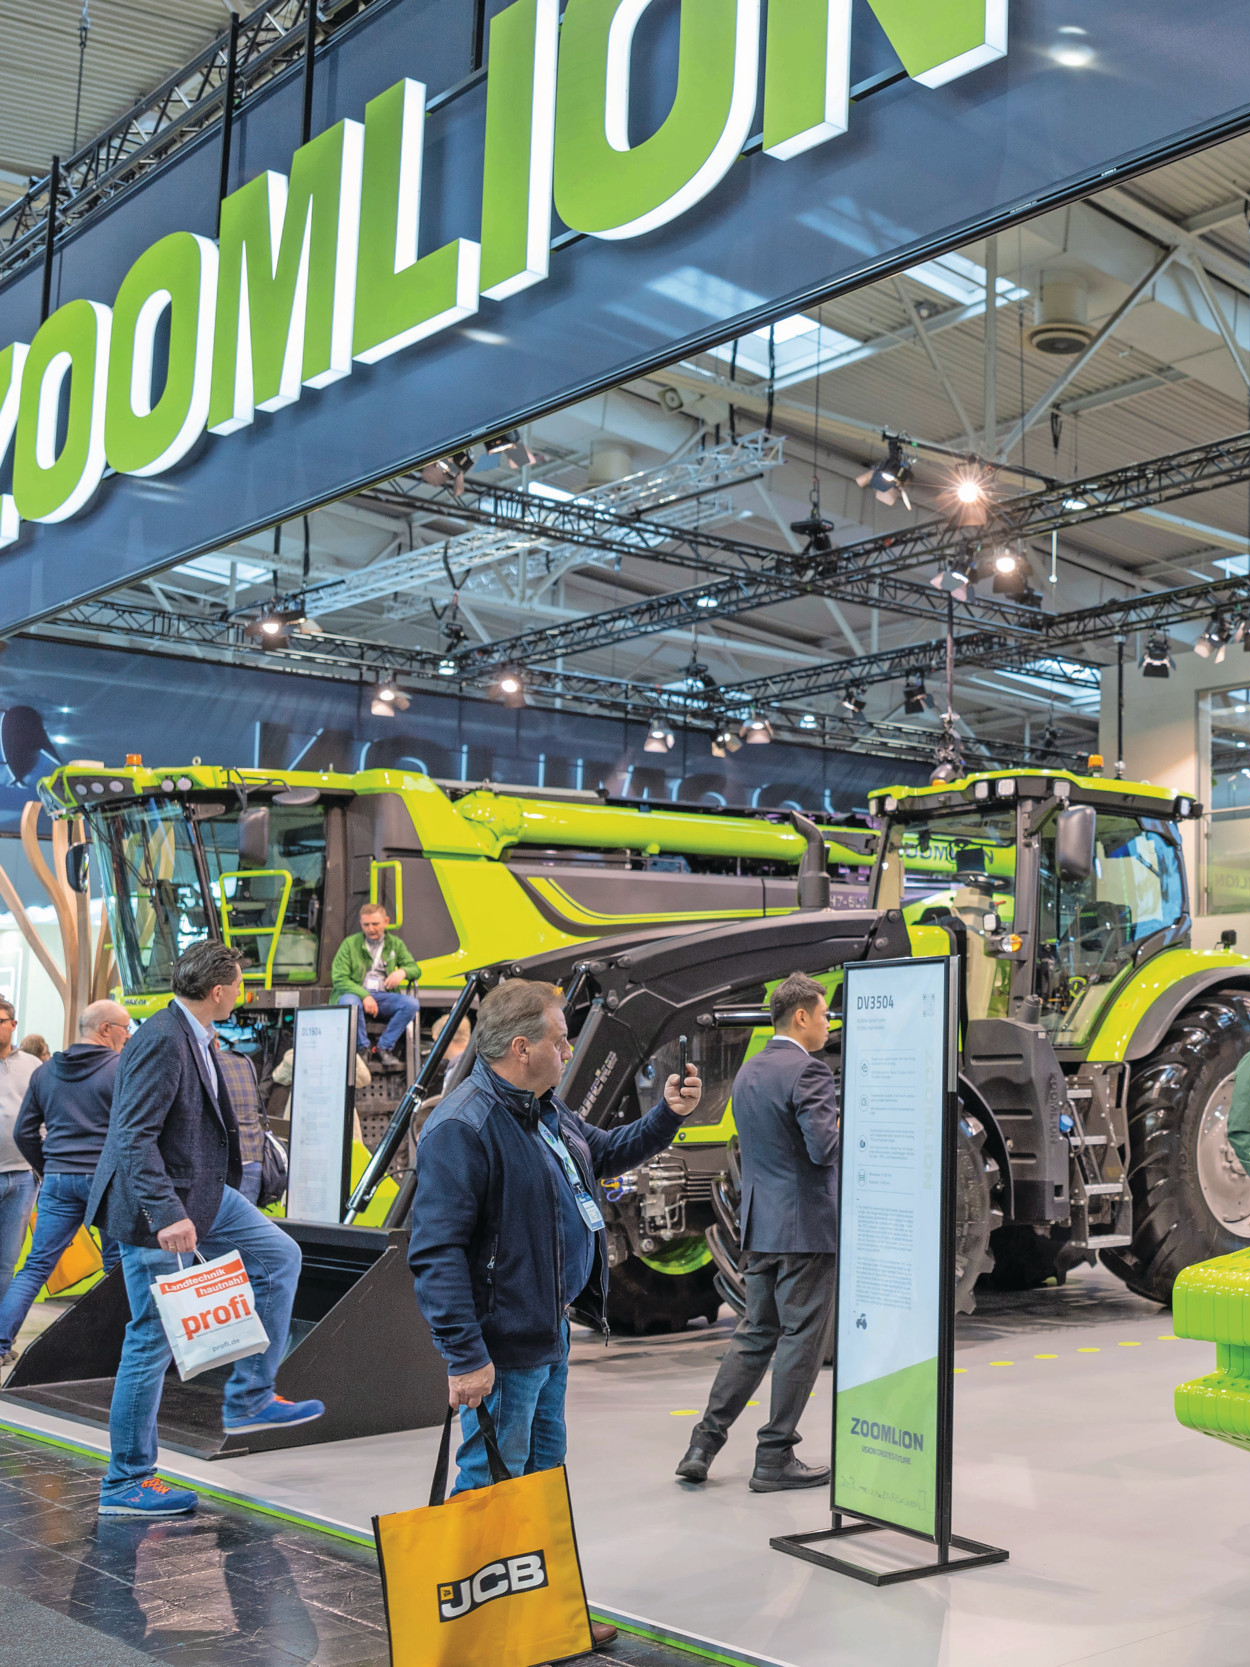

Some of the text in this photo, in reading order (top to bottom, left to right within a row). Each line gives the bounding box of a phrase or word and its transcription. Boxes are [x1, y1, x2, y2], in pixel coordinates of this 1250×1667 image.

[857, 995, 894, 1010] DV3504
[164, 1268, 226, 1292] Landtechnik
[200, 1276, 245, 1296] hautnah!
[181, 1293, 252, 1342] profi
[212, 1337, 240, 1353] profi.de
[850, 1417, 924, 1452] ZOOMLION
[441, 1554, 545, 1619] JCB
